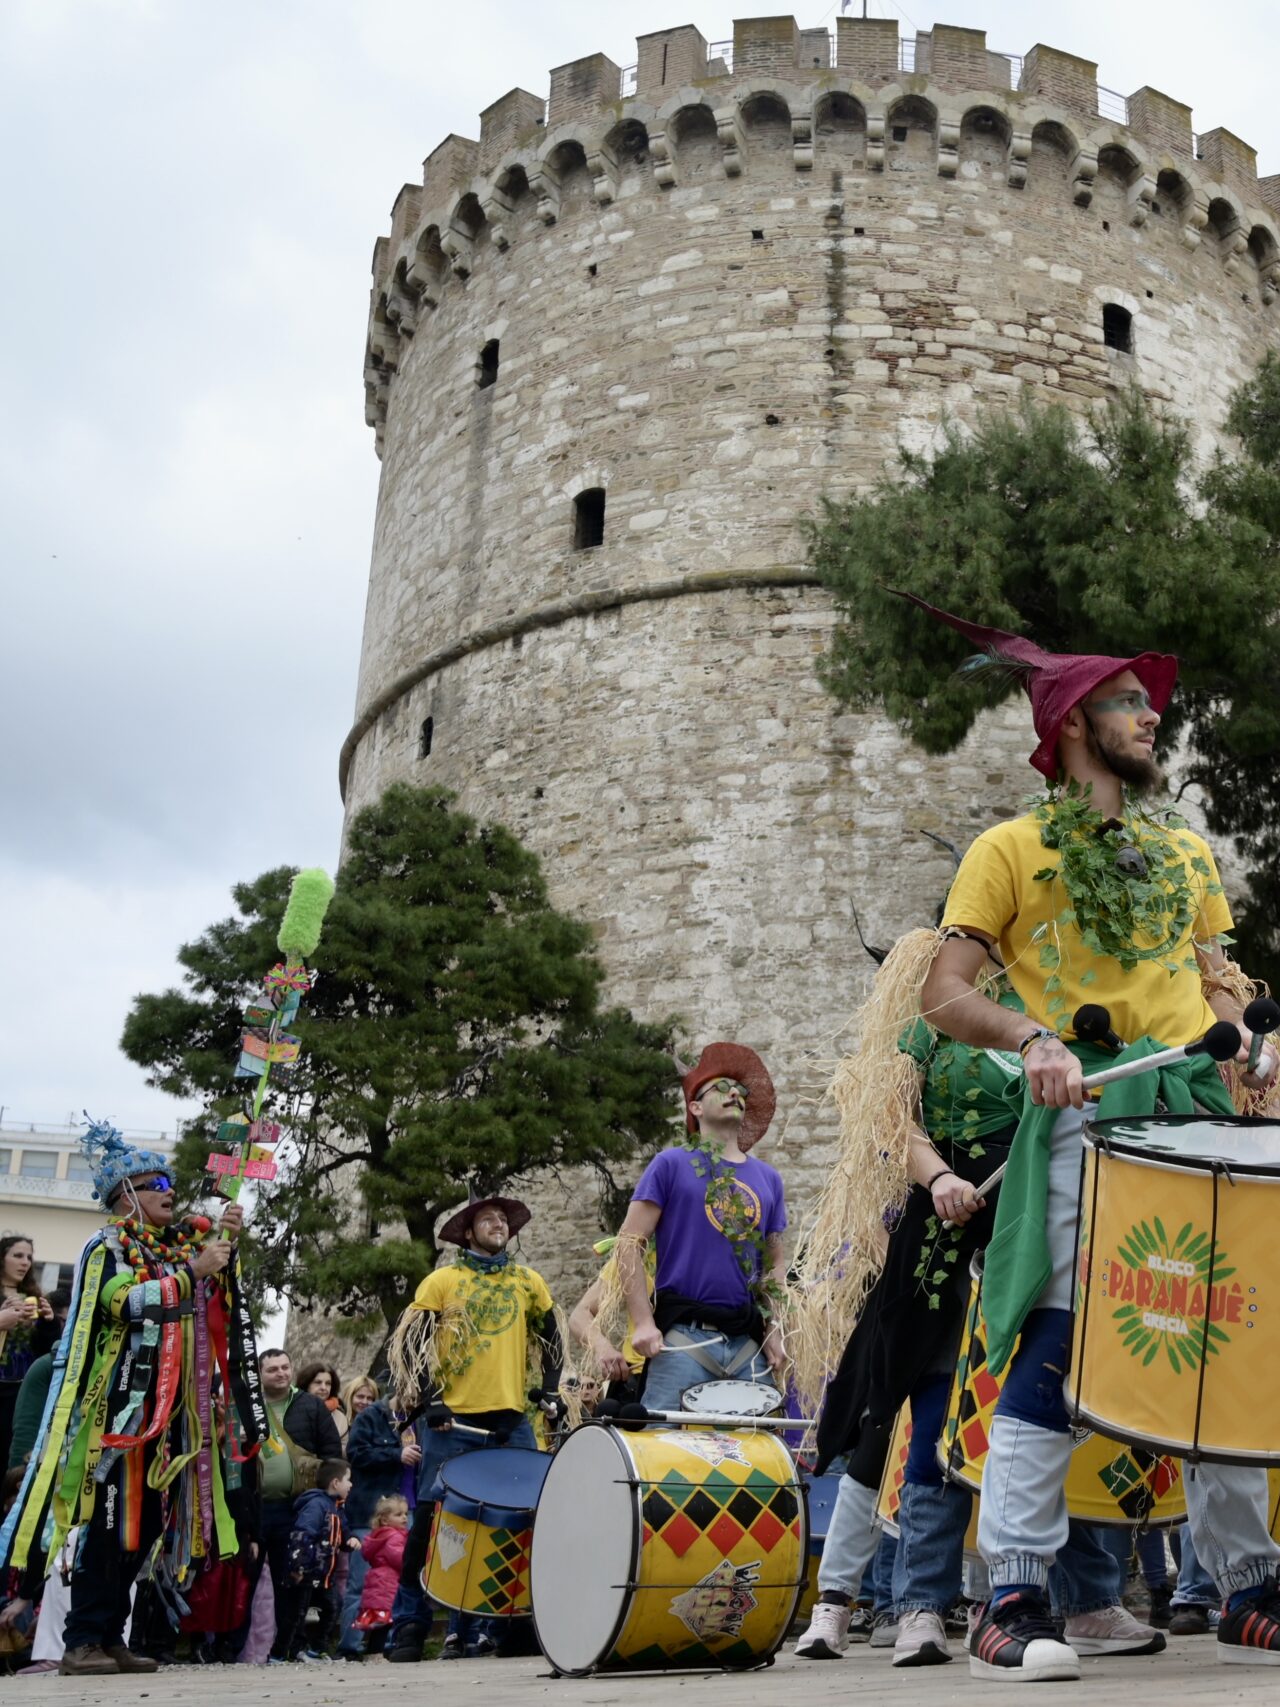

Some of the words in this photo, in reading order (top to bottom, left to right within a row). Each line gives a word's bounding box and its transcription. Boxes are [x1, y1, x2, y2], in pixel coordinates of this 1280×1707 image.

[1147, 1254, 1196, 1277] BLOCO
[85, 1275, 98, 1298] YORK
[1109, 1260, 1245, 1323] PARANAUÊ
[80, 1301, 93, 1324] NEW
[240, 1308, 250, 1325] VIP
[1142, 1311, 1190, 1335] GRECIA
[69, 1330, 86, 1384] AMSTERDAM
[243, 1338, 254, 1357] VIP
[119, 1350, 134, 1391] travelbags
[247, 1370, 259, 1389] VIP
[252, 1403, 264, 1421] VIP
[84, 1462, 99, 1495] GATE
[105, 1484, 118, 1529] travelbags
